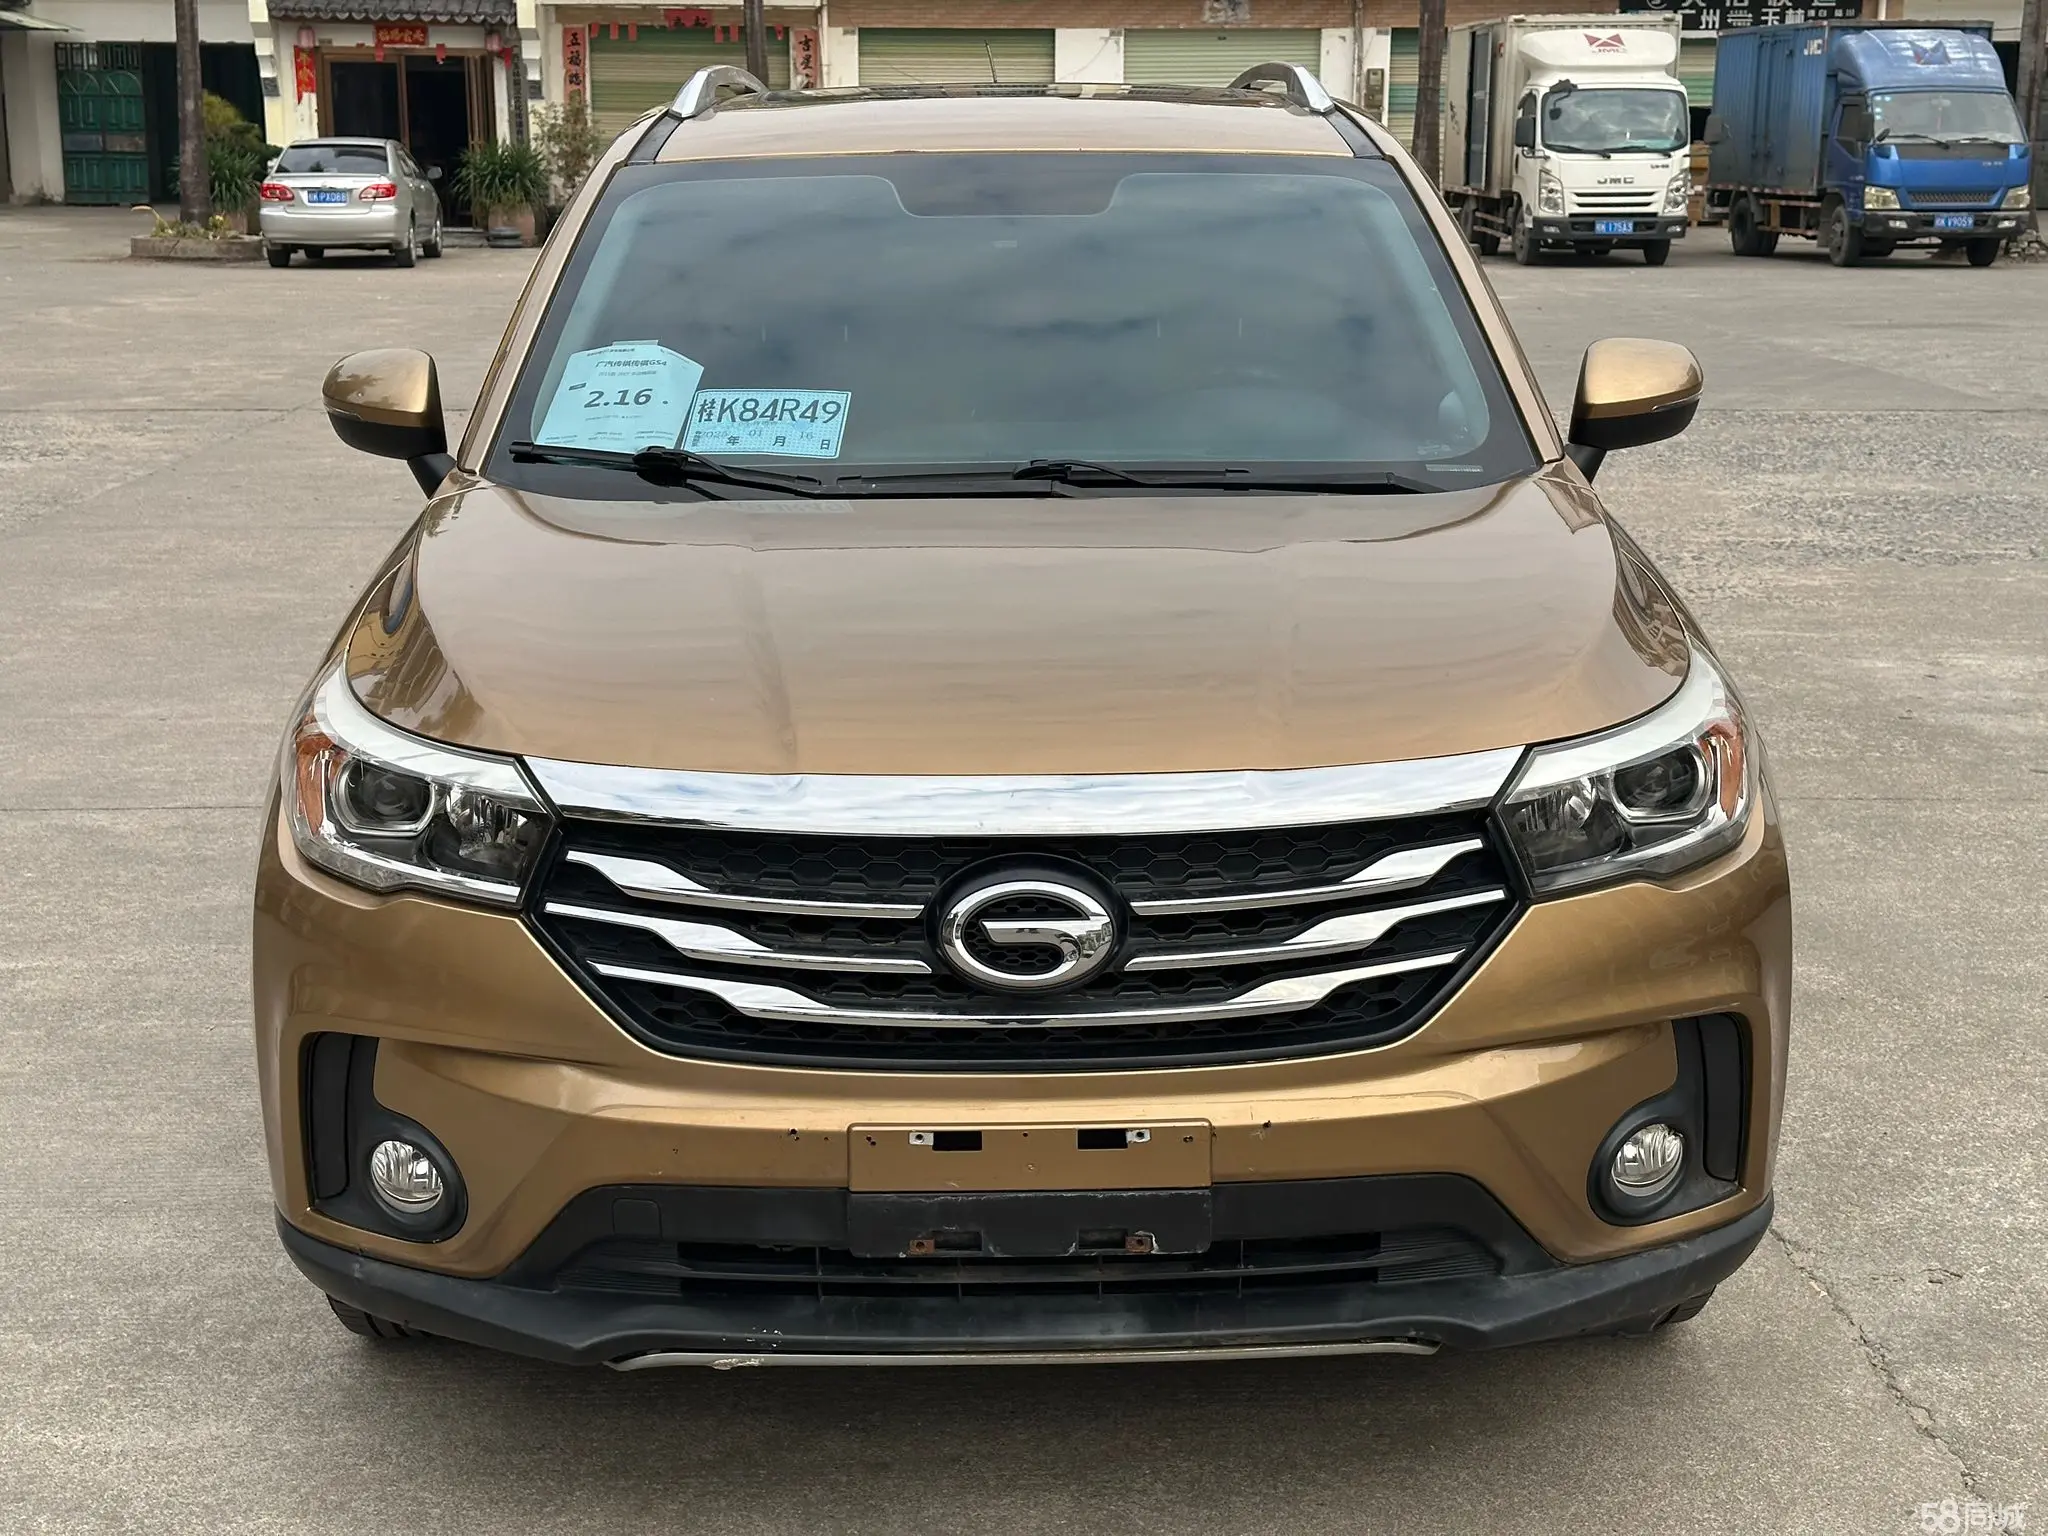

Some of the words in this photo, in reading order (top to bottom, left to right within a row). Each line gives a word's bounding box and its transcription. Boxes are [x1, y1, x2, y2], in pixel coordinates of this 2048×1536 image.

[1597, 176, 1634, 185] JMC
[584, 388, 653, 408] 2.16
[697, 397, 842, 424] 桂K84R49
[726, 435, 740, 447] 年
[773, 435, 786, 447] 月
[820, 439, 831, 450] 日
